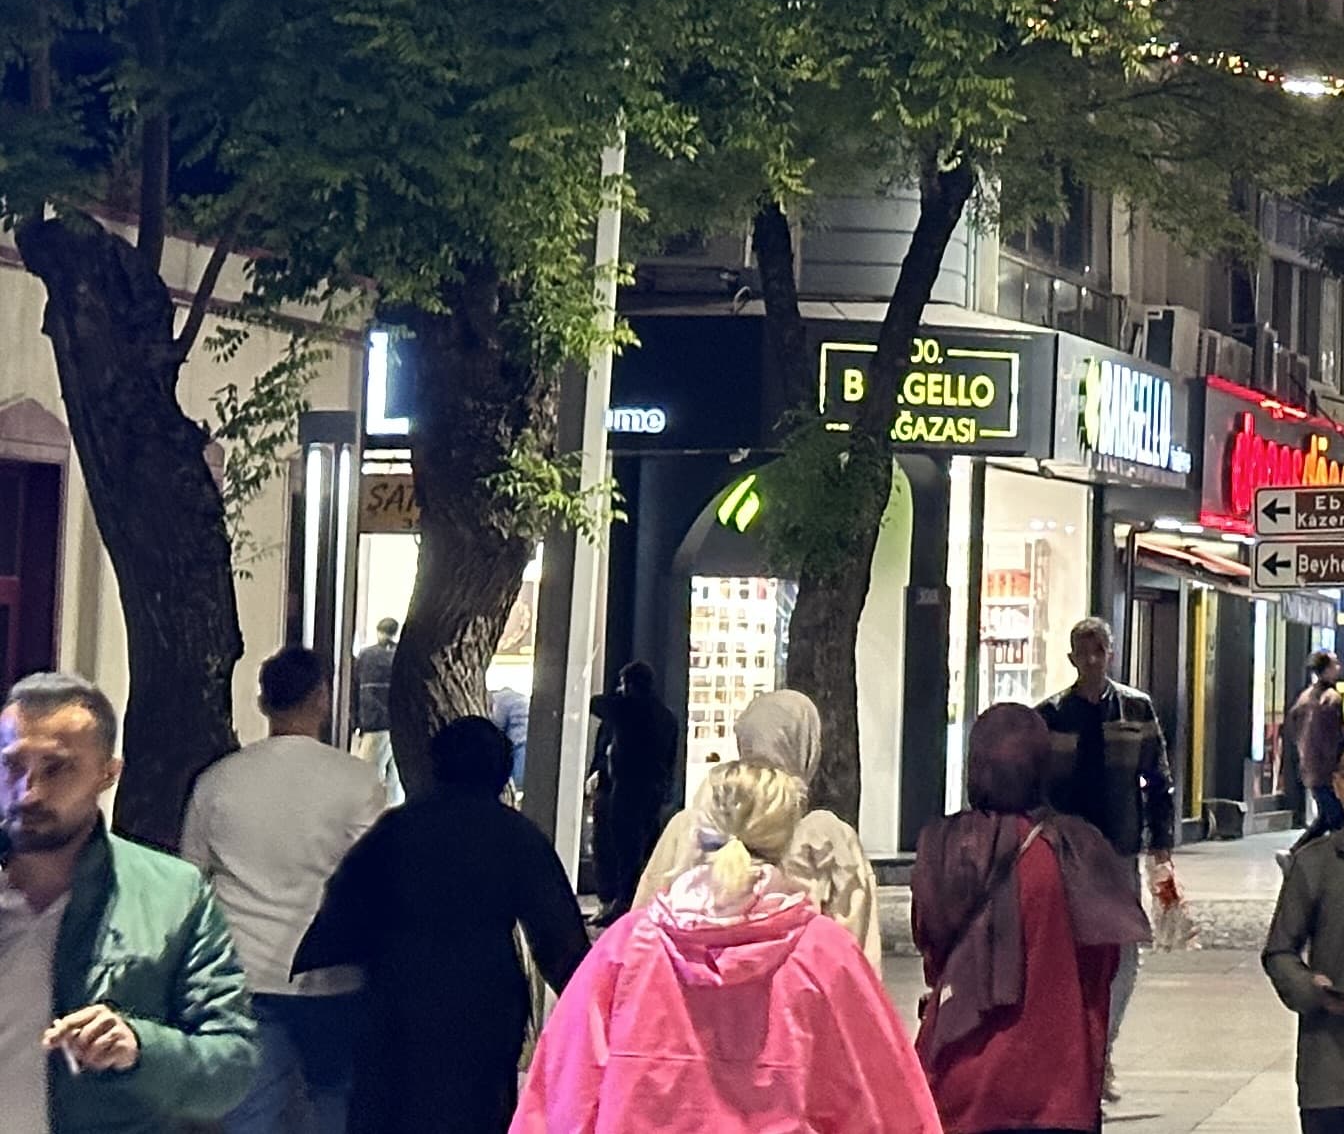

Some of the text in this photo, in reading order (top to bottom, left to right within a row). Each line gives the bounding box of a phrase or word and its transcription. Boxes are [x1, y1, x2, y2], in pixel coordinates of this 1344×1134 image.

[843, 369, 995, 408] BGELLO
[890, 410, 976, 443] ĞAZASI
[1098, 360, 1172, 469] BARGELLO
